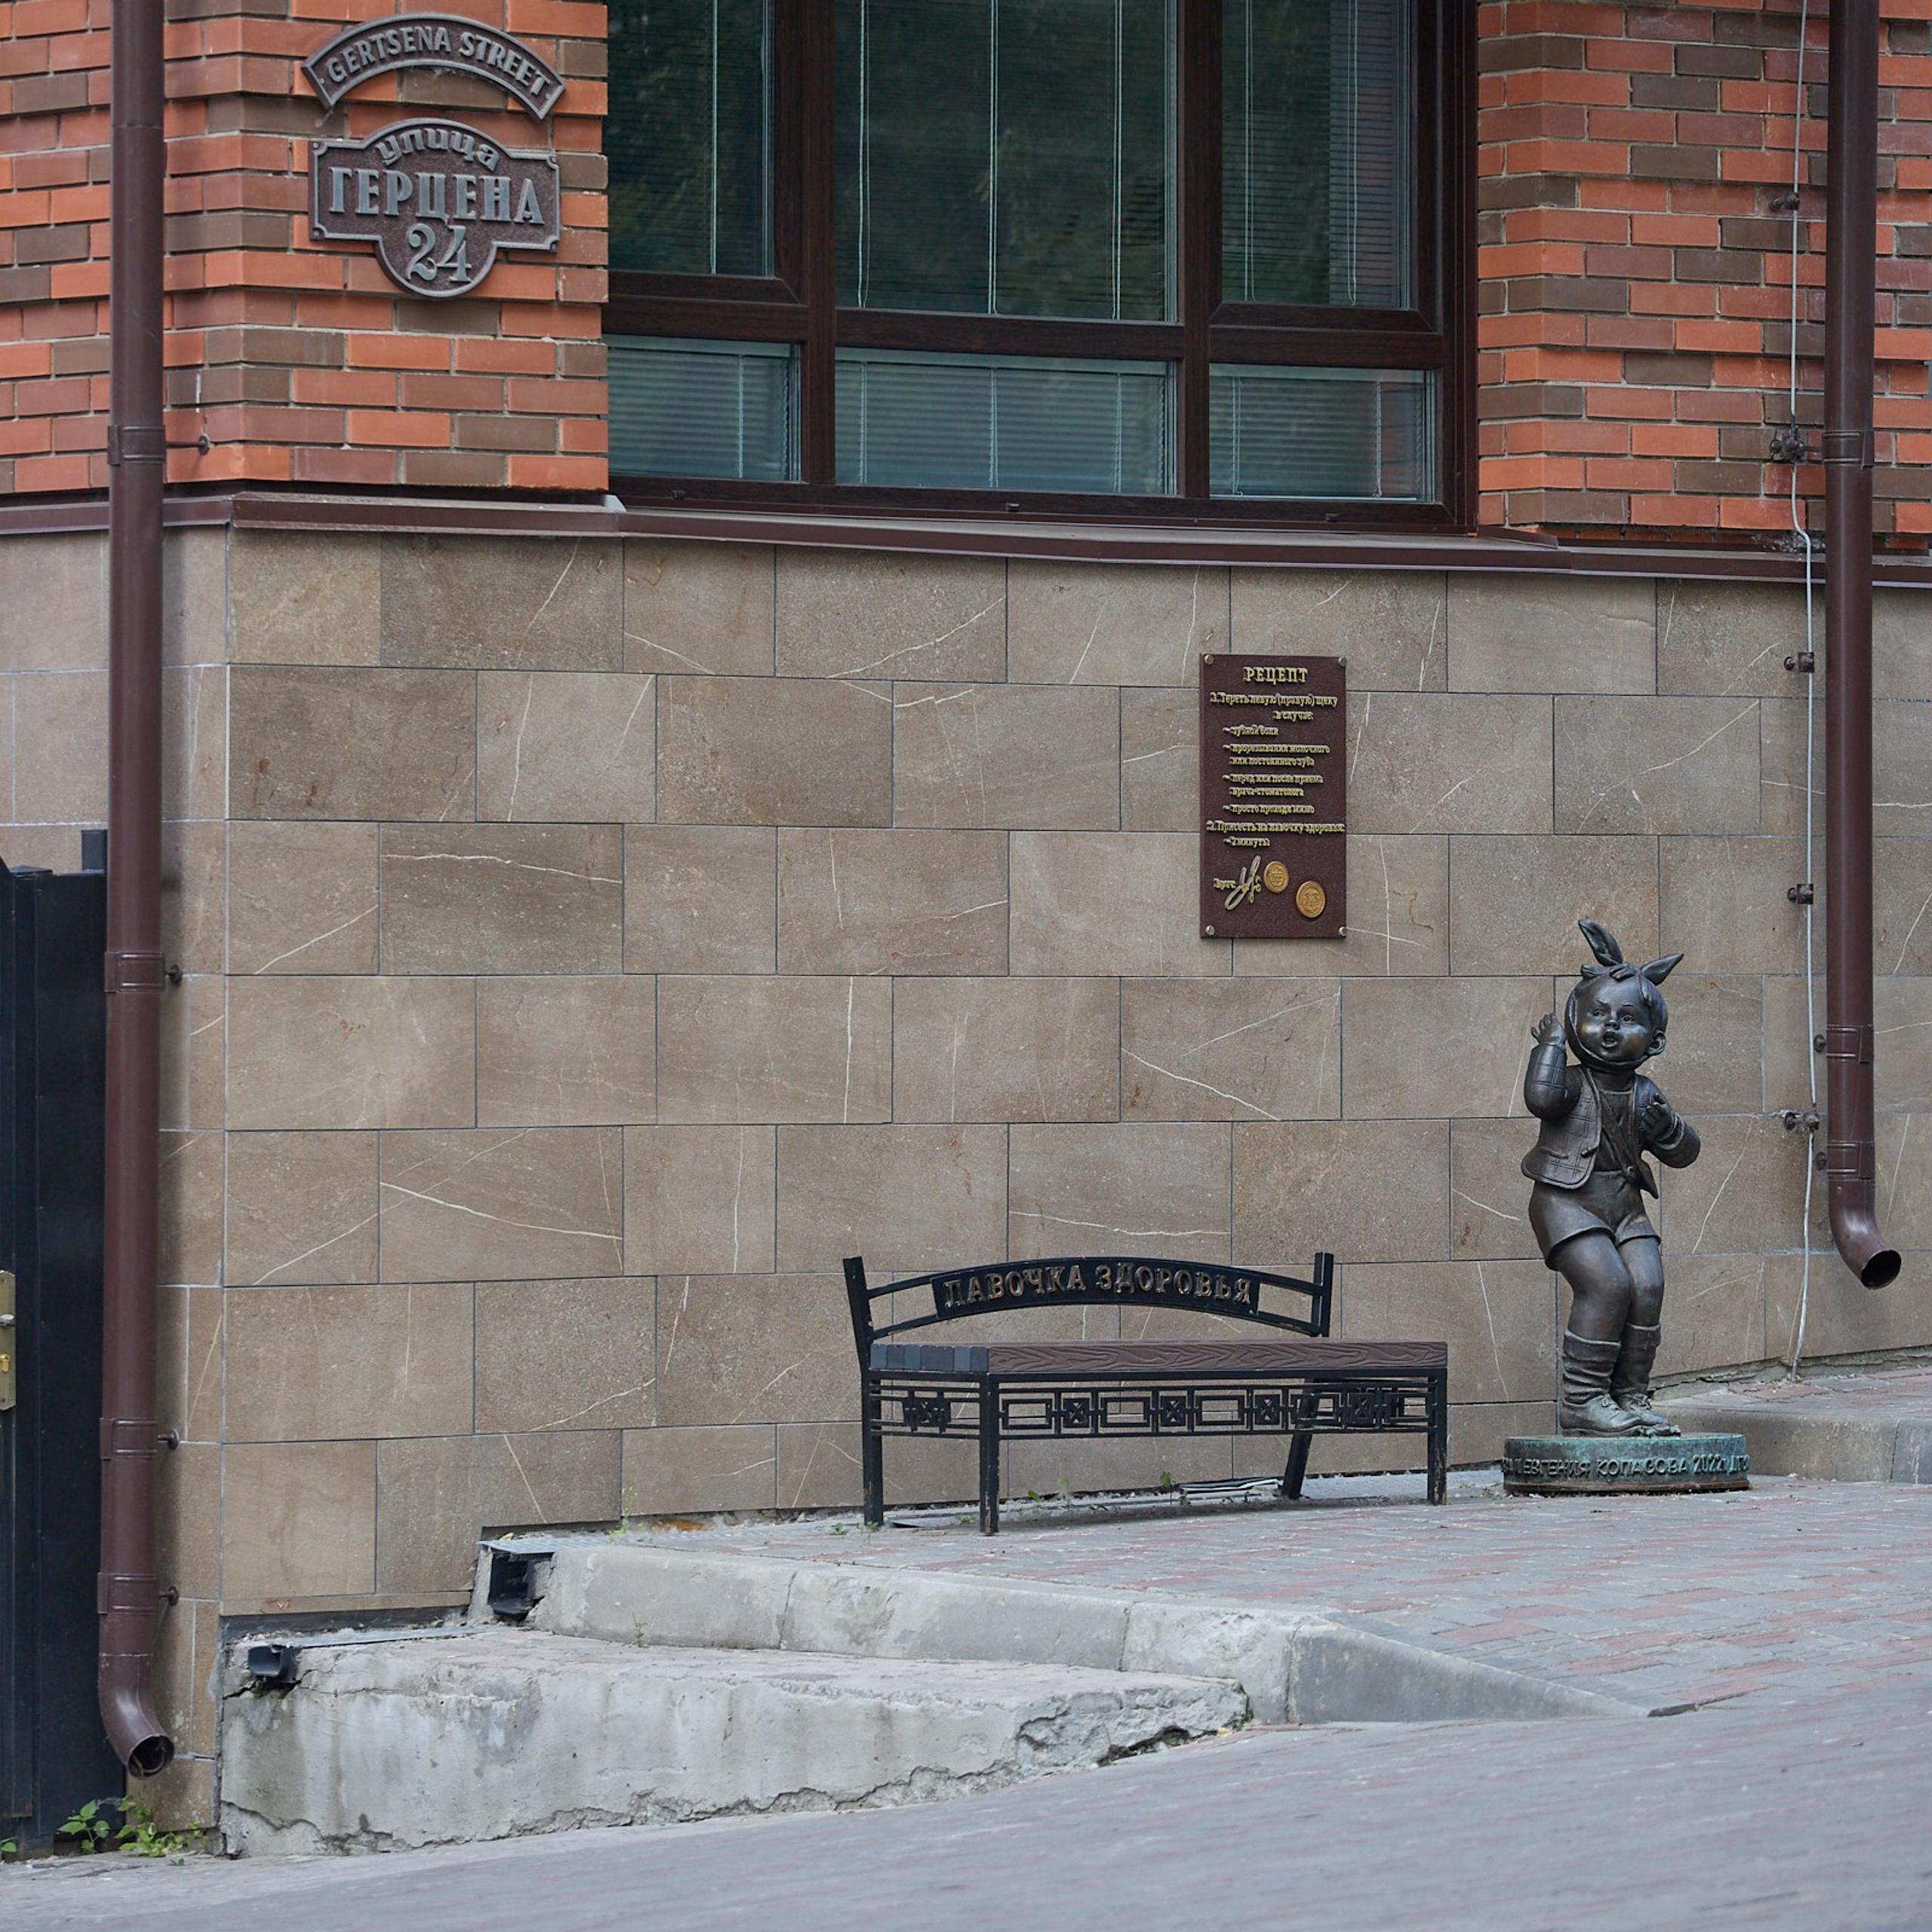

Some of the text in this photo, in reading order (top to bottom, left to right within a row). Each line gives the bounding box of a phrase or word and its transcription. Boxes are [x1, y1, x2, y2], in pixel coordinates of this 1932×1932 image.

[328, 26, 551, 96] GERTSENA STREET
[376, 128, 500, 171] улица
[329, 167, 545, 226] ГЕРЦЕНА
[406, 223, 472, 282] 24
[1243, 666, 1308, 685] РЕЦЕПТ
[1218, 693, 1249, 706] Тереть
[1249, 694, 1275, 706] левую
[1276, 693, 1315, 707] (правую)
[1315, 696, 1338, 708] щеку
[945, 1261, 1251, 1309] ЛАВОЧКА ЗДОРОВЬЯ
[1524, 1457, 1590, 1477] ЕВГЕНИЯ
